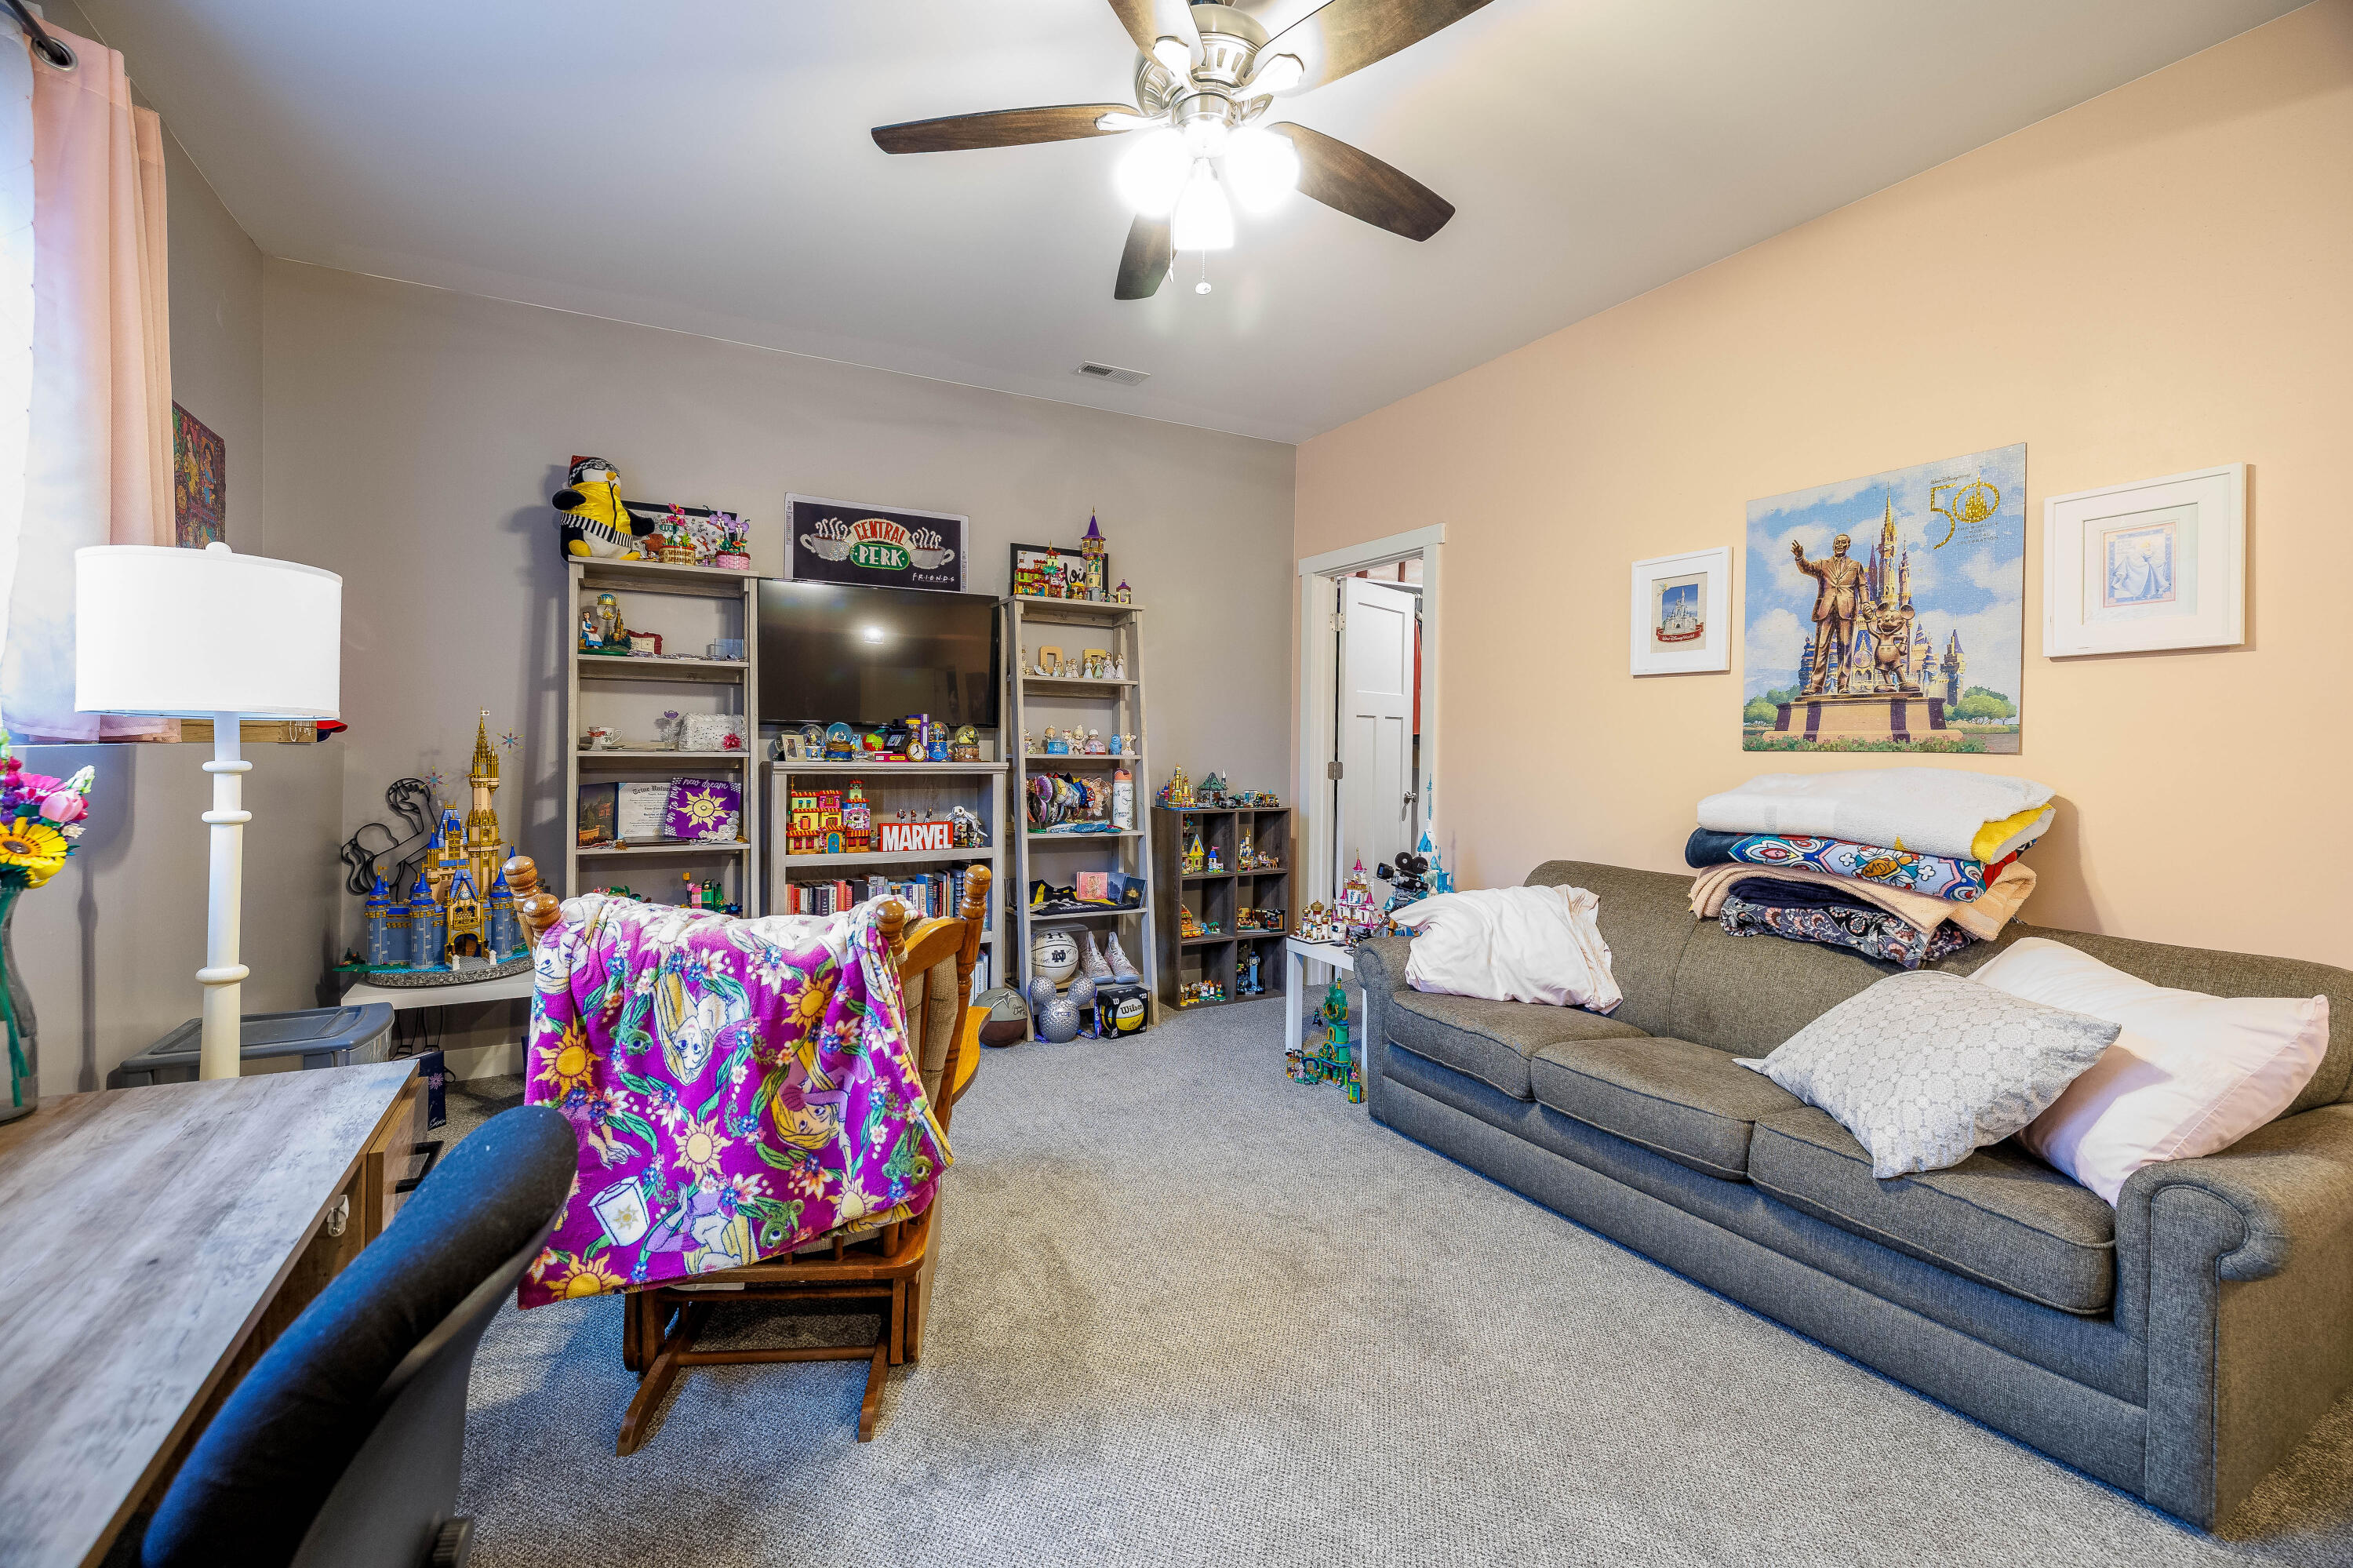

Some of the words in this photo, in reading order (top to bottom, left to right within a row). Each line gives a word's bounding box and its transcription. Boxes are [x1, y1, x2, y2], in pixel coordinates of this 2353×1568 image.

[854, 520, 906, 545] CENTRAL
[858, 544, 903, 567] PERK
[702, 780, 729, 789] dream
[670, 785, 682, 799] my
[668, 801, 678, 810] to
[667, 812, 676, 823] on
[882, 824, 952, 851] MARVEL
[1120, 1004, 1143, 1014] Wilson
